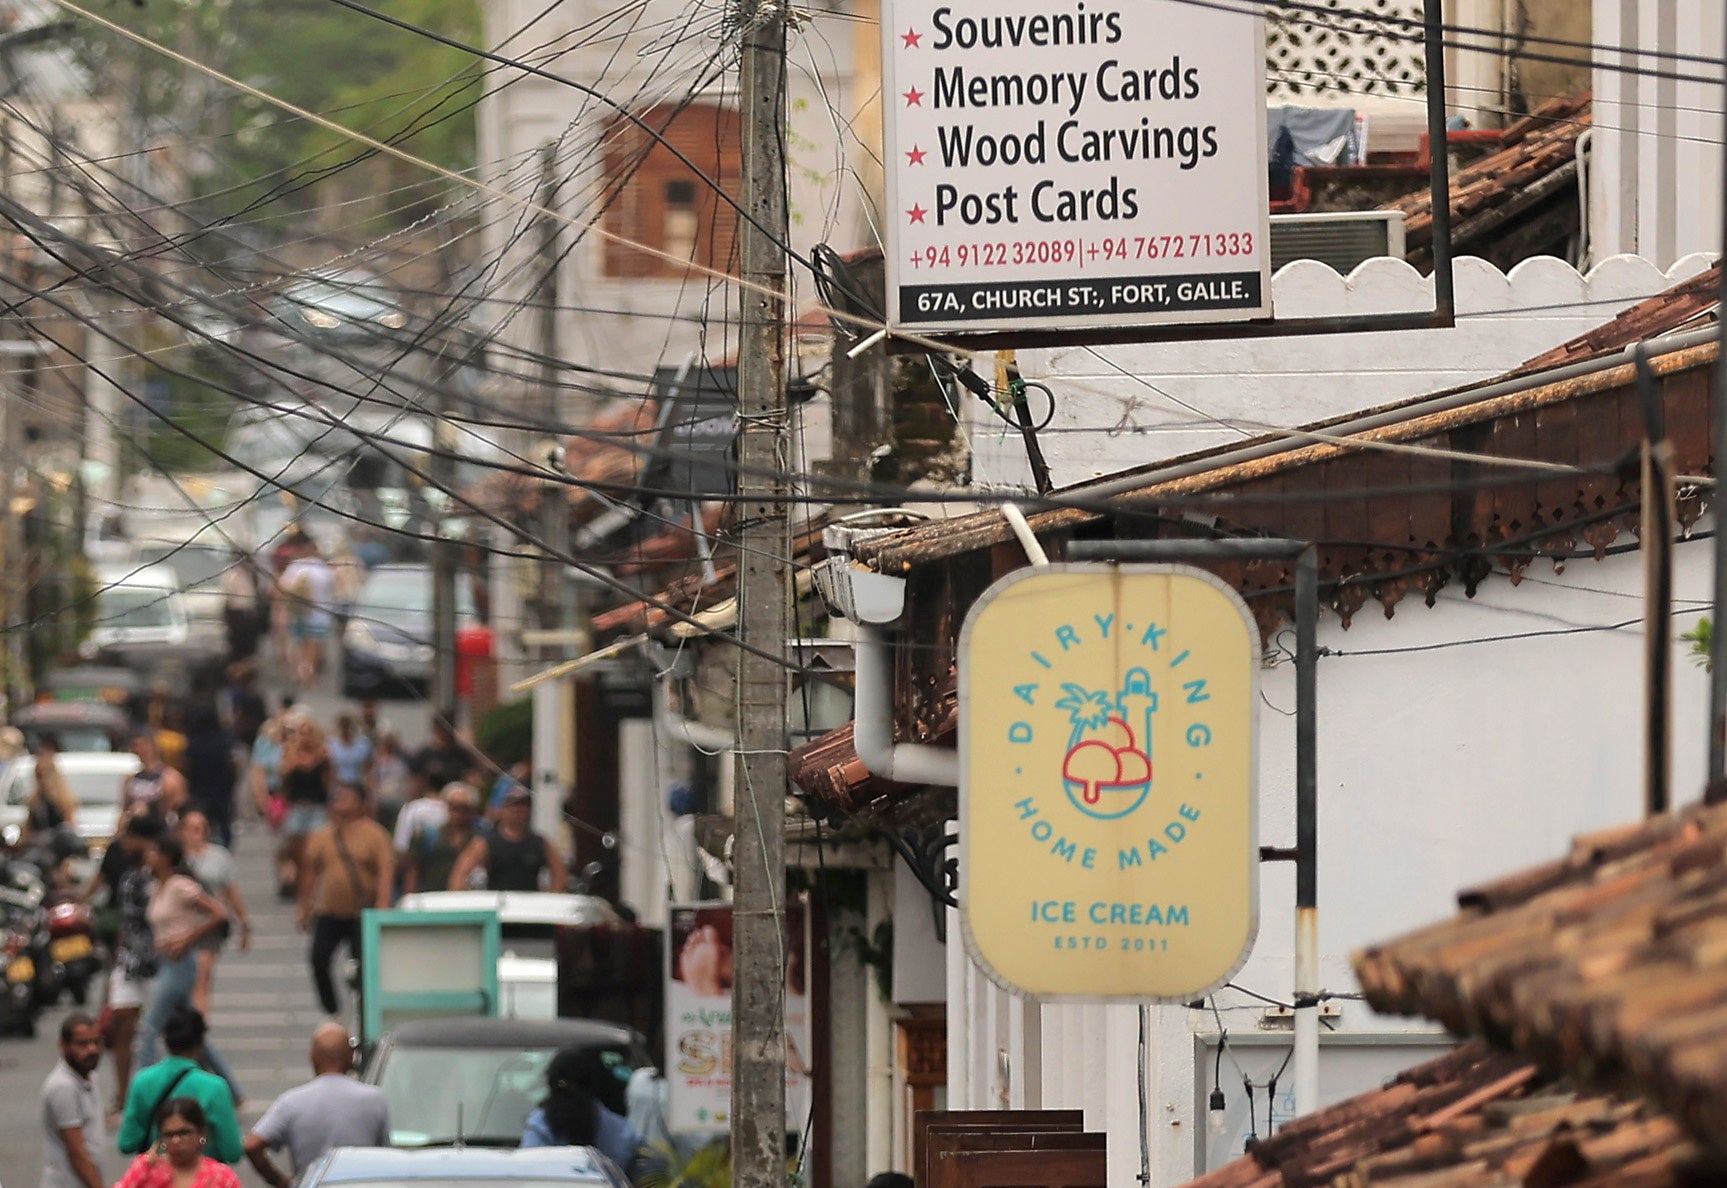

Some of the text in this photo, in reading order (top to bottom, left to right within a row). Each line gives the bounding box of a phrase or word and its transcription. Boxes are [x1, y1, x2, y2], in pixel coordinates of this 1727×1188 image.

[932, 3, 1122, 50] Souvenirs
[933, 56, 1200, 117] Memory Cards
[938, 117, 1218, 170] Wood Carvings
[935, 176, 1138, 226] Post Cards
[910, 245, 951, 268] +94
[958, 242, 1007, 267] 9122
[1134, 236, 1184, 261] 7672
[1189, 232, 1253, 258] 71333
[917, 291, 966, 314] 67A,
[971, 287, 1061, 311] CHURCH
[1111, 282, 1171, 305] FORT,
[1177, 280, 1249, 302] GALLE.
[1009, 613, 1211, 746] DAIRY KING
[1014, 797, 1200, 870] HOME MADE
[1031, 901, 1189, 926] ICE CREAM
[1055, 936, 1168, 951] ESTD 2011
